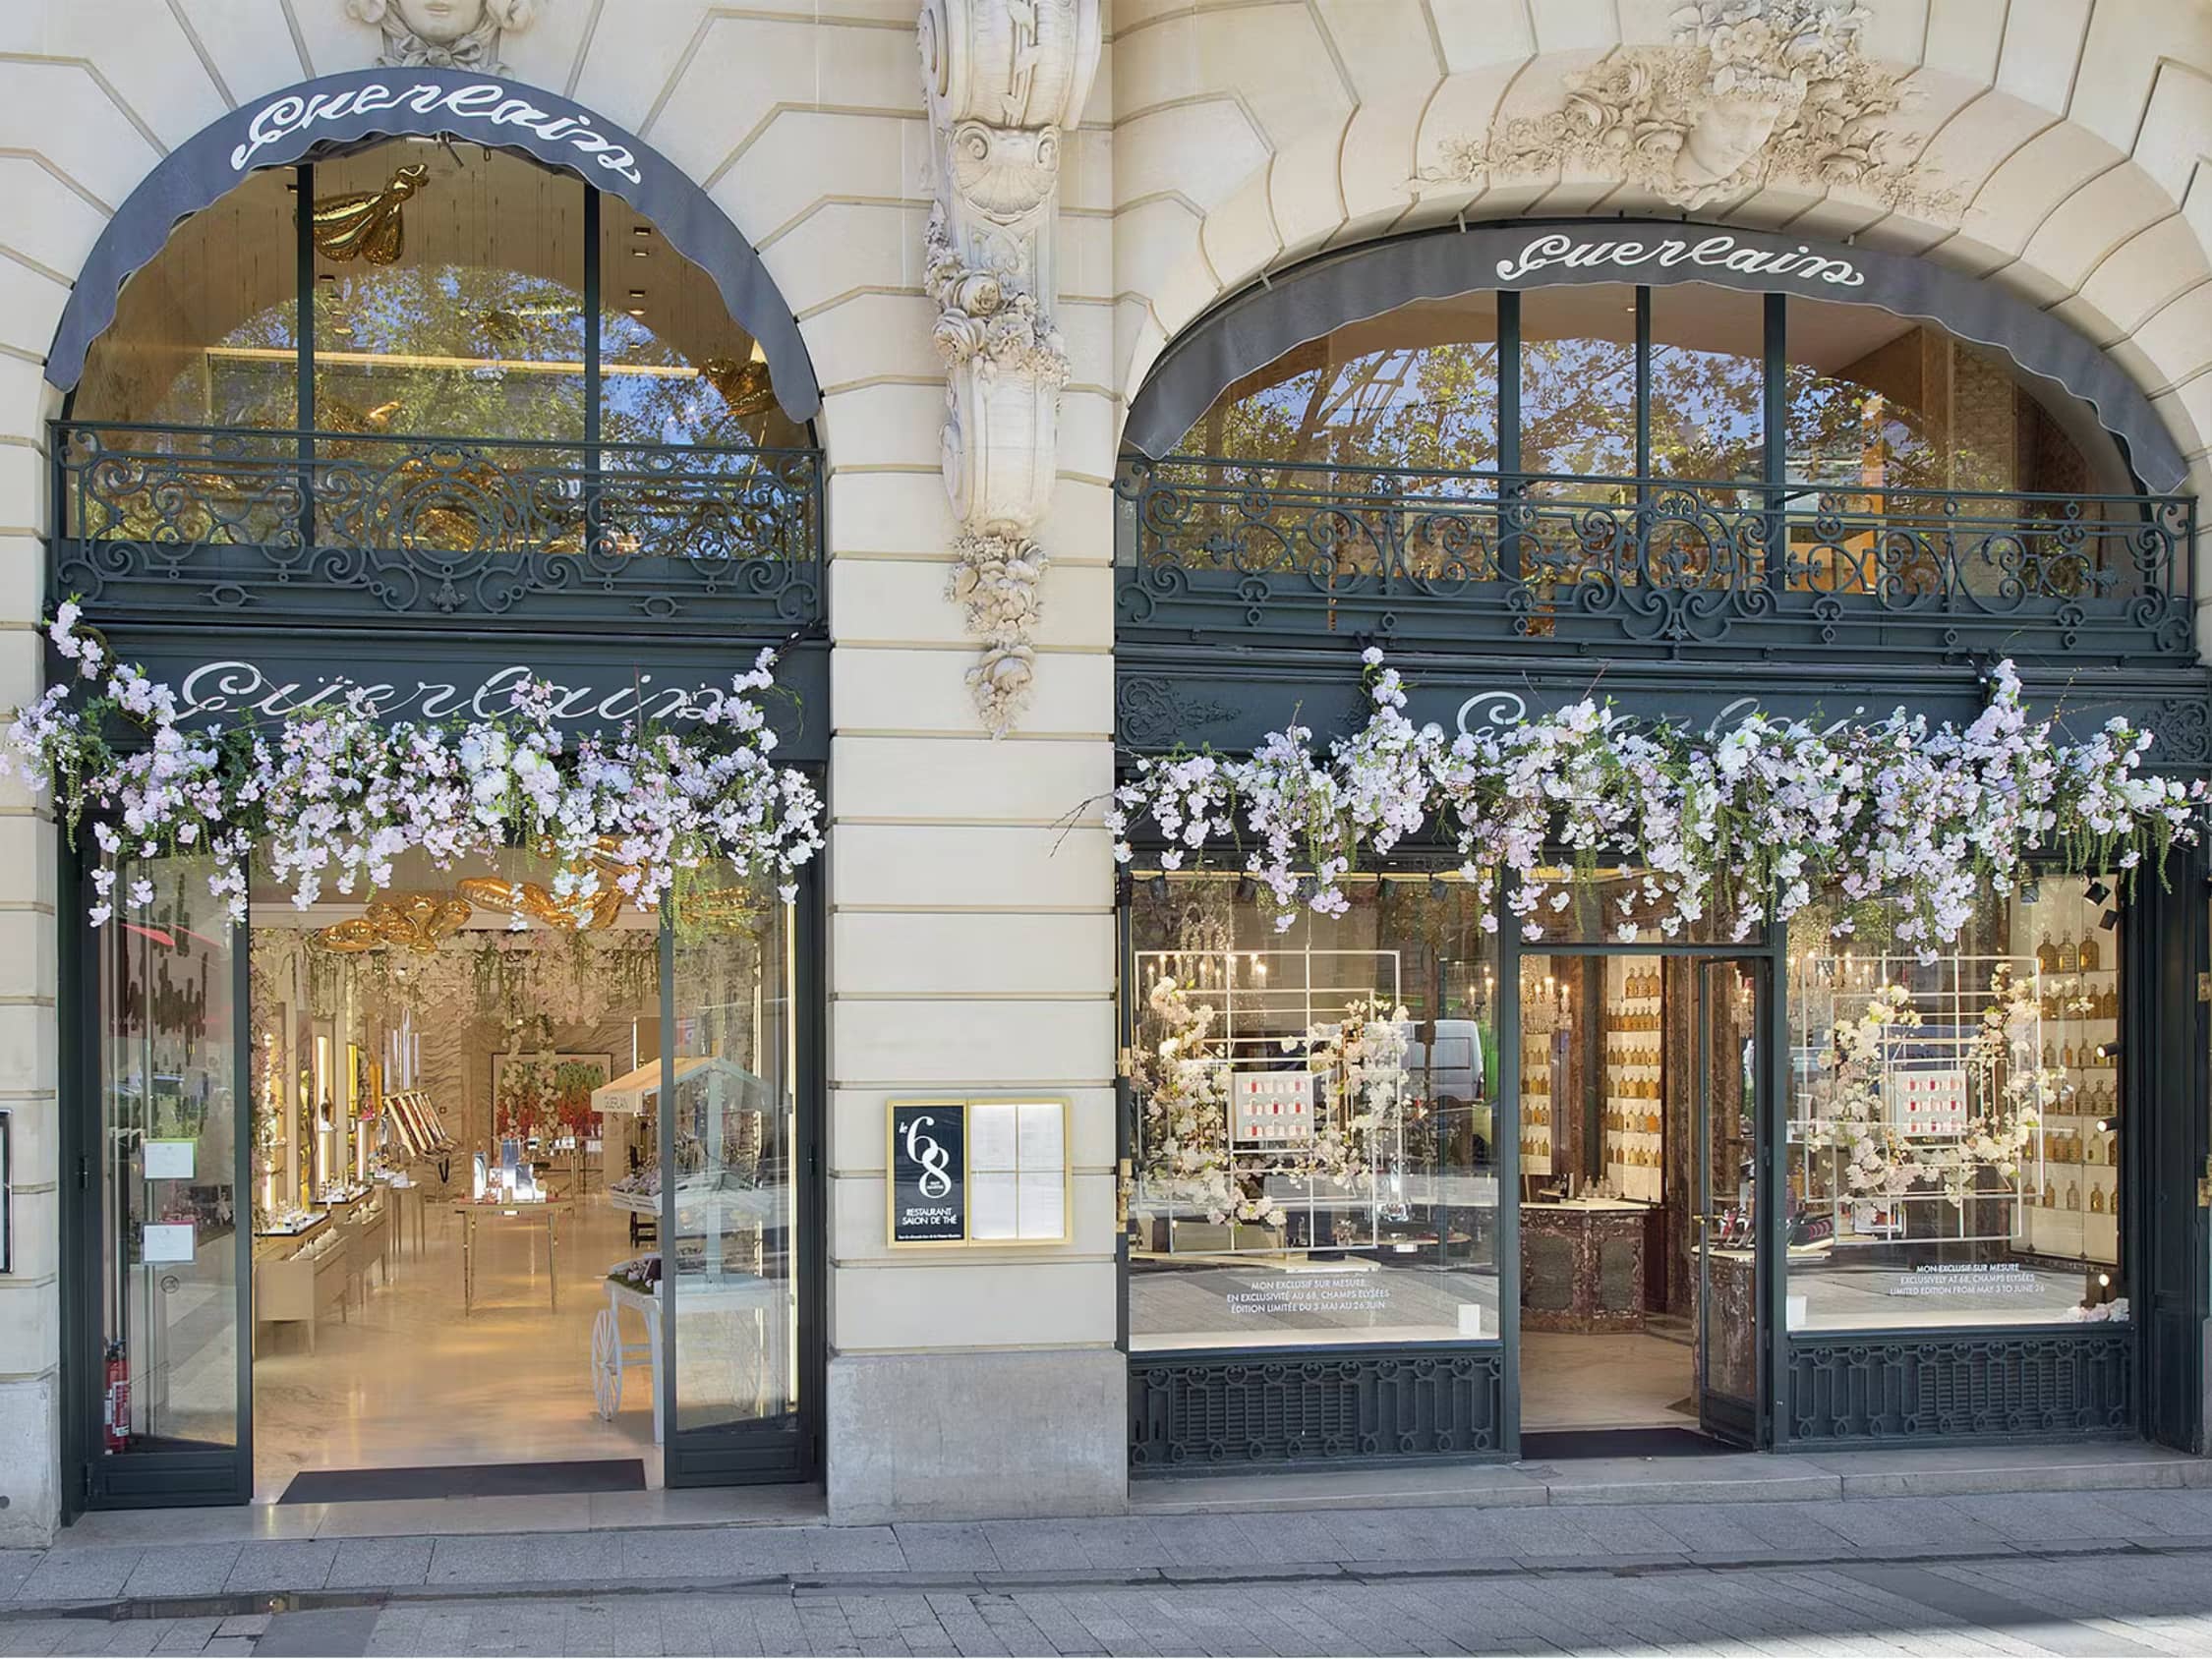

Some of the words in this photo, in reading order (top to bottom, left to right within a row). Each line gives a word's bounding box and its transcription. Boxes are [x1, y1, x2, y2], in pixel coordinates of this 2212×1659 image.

[231, 84, 642, 185] Guerlain
[1496, 234, 1865, 286] Guerlain
[905, 1207, 953, 1217] RESTAURANT
[902, 1216, 929, 1226] SALON
[930, 1216, 941, 1225] DE
[943, 1214, 958, 1225] THÉ
[1915, 1264, 1937, 1274] MON
[1938, 1263, 1971, 1273] EXCLUSIF
[1972, 1263, 1988, 1273] SUR
[1989, 1262, 2020, 1273] MESURE
[1252, 1281, 1274, 1290] MON
[1276, 1280, 1311, 1289] EXCLUSIF
[1313, 1279, 1331, 1288] SUR
[1332, 1278, 1365, 1287] MESURE
[1900, 1275, 1947, 1285] EXCLUSIVELY
[1972, 1273, 2005, 1283] CHAMPS
[1227, 1292, 1240, 1302] EN
[1241, 1289, 1291, 1302] EXCLUSIVITÉ
[1291, 1290, 1305, 1300] AU
[1320, 1289, 1358, 1299] CHAMPS
[1890, 1286, 1919, 1295] LIMITED
[1299, 1302, 1312, 1311] DU
[1320, 1301, 1338, 1310] MAI
[1339, 1300, 1353, 1310] AU
[1366, 1299, 1385, 1310] JUIN
